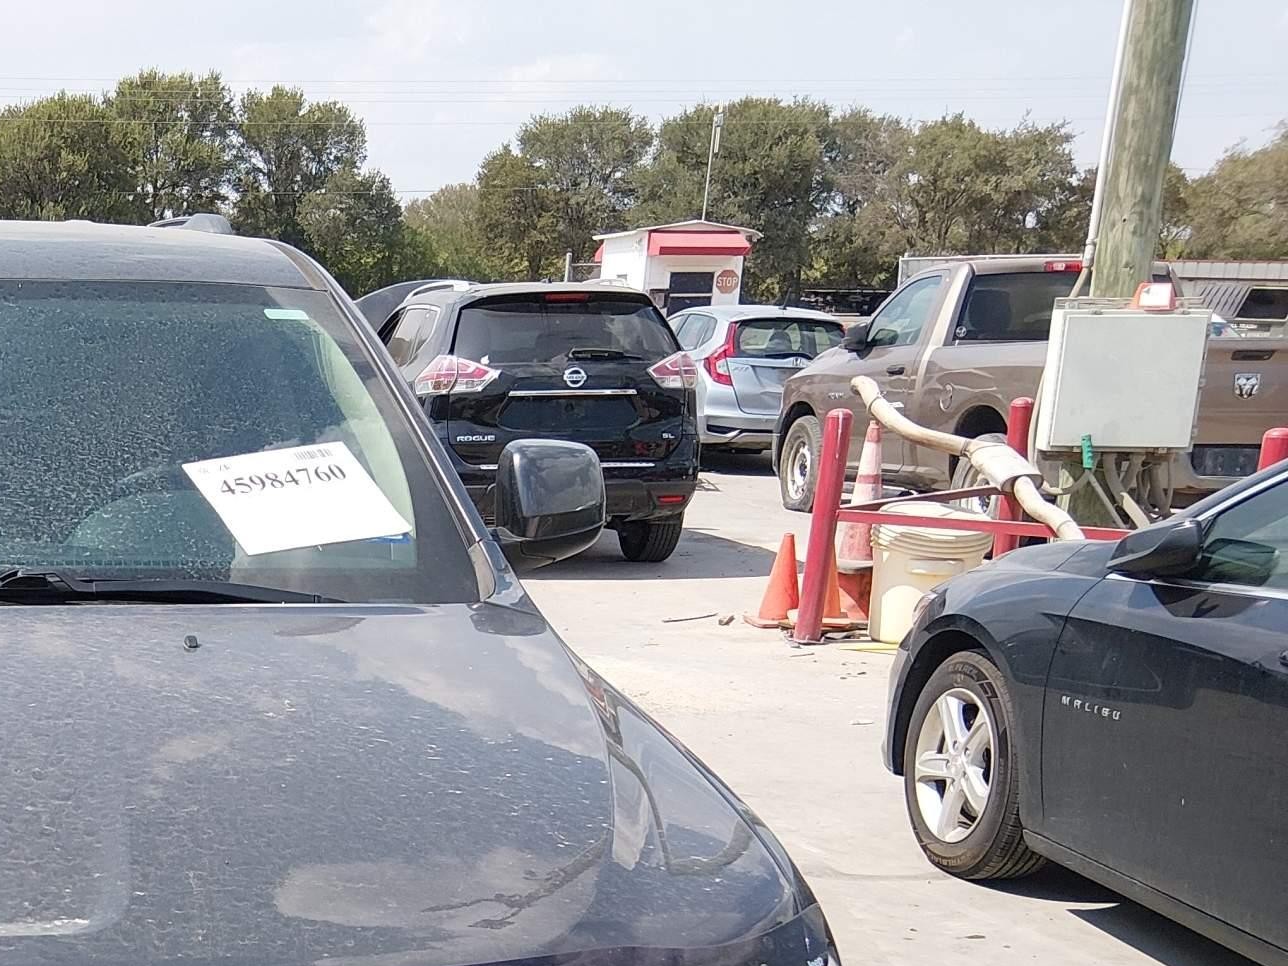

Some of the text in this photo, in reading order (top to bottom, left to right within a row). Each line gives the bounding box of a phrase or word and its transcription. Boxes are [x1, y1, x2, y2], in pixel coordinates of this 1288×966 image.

[717, 277, 738, 287] STOP
[220, 463, 346, 496] 45984760
[1061, 695, 1121, 720] MALIBU
